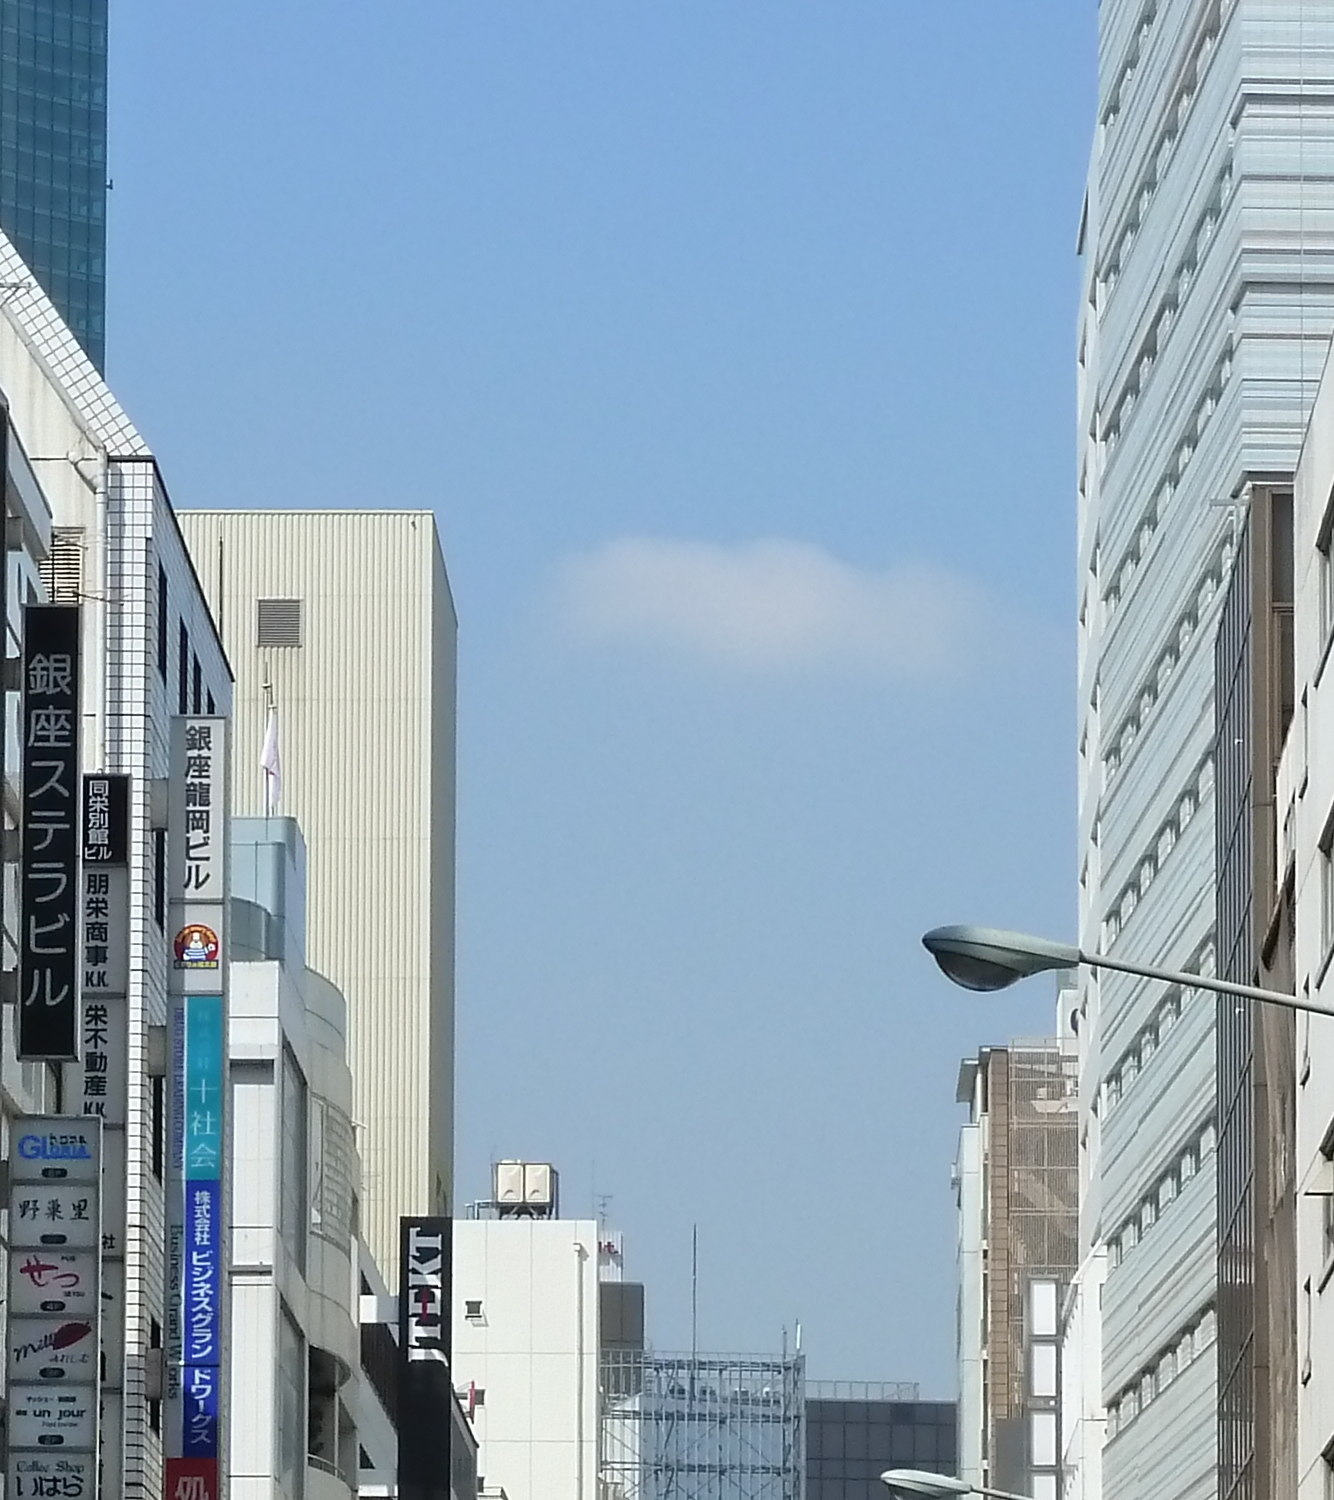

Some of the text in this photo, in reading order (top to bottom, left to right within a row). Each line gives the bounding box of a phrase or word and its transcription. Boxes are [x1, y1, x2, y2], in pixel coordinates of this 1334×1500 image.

[25, 652, 72, 1007] 銀座ステラビル
[84, 780, 112, 861] 同栄別館ビル
[183, 724, 212, 891] 銀座龍岡ビル
[19, 1255, 79, 1288] せつ
[169, 1224, 183, 1290] Business
[169, 1294, 183, 1340] Grand
[191, 1190, 214, 1445] 株式会社 ビジネスグランドワークス
[408, 1227, 449, 1368] JTEKT
[33, 1409, 51, 1418] un
[57, 1408, 86, 1420] jour
[55, 1460, 84, 1474] Shop
